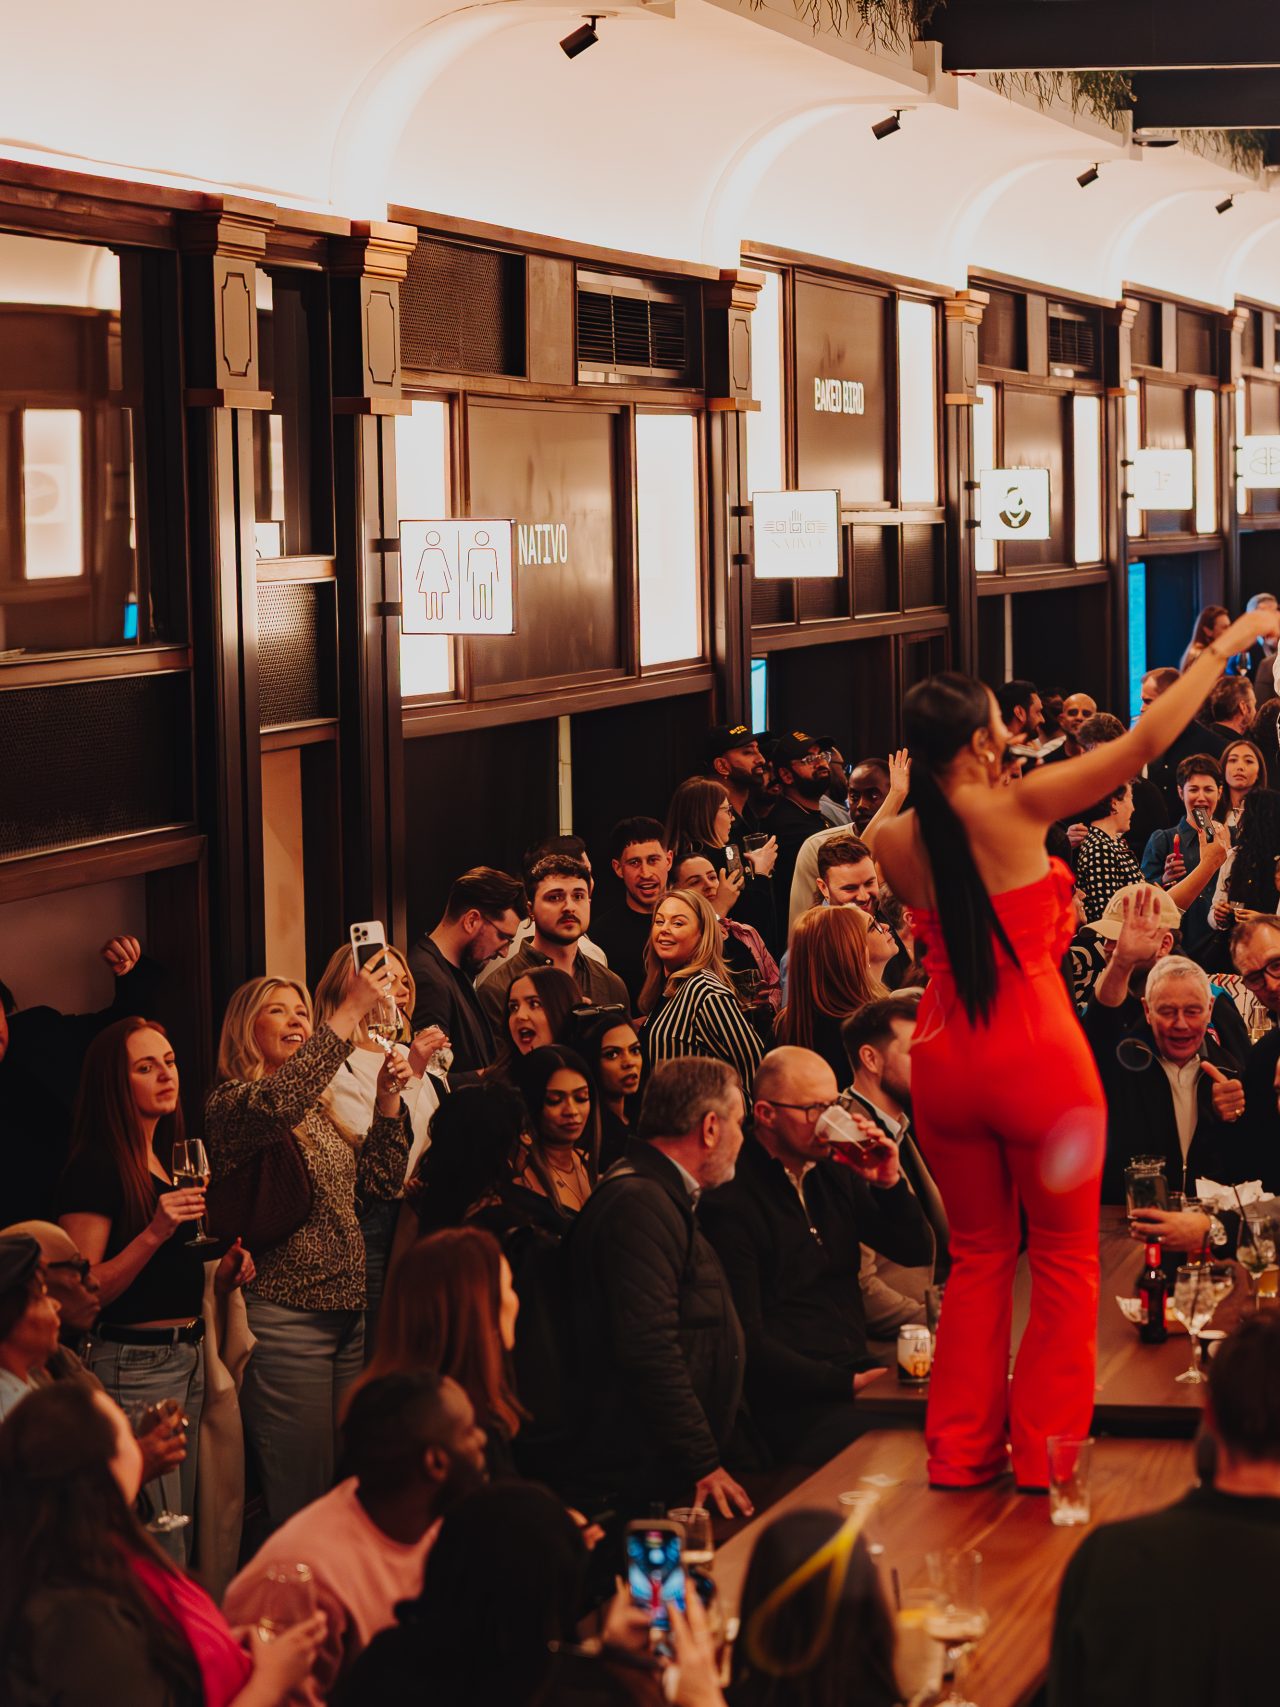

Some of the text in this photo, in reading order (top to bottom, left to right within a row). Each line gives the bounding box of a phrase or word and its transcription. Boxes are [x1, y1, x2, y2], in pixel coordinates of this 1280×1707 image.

[814, 377, 865, 415] BAKED BIRD
[518, 523, 568, 566] NATIVO
